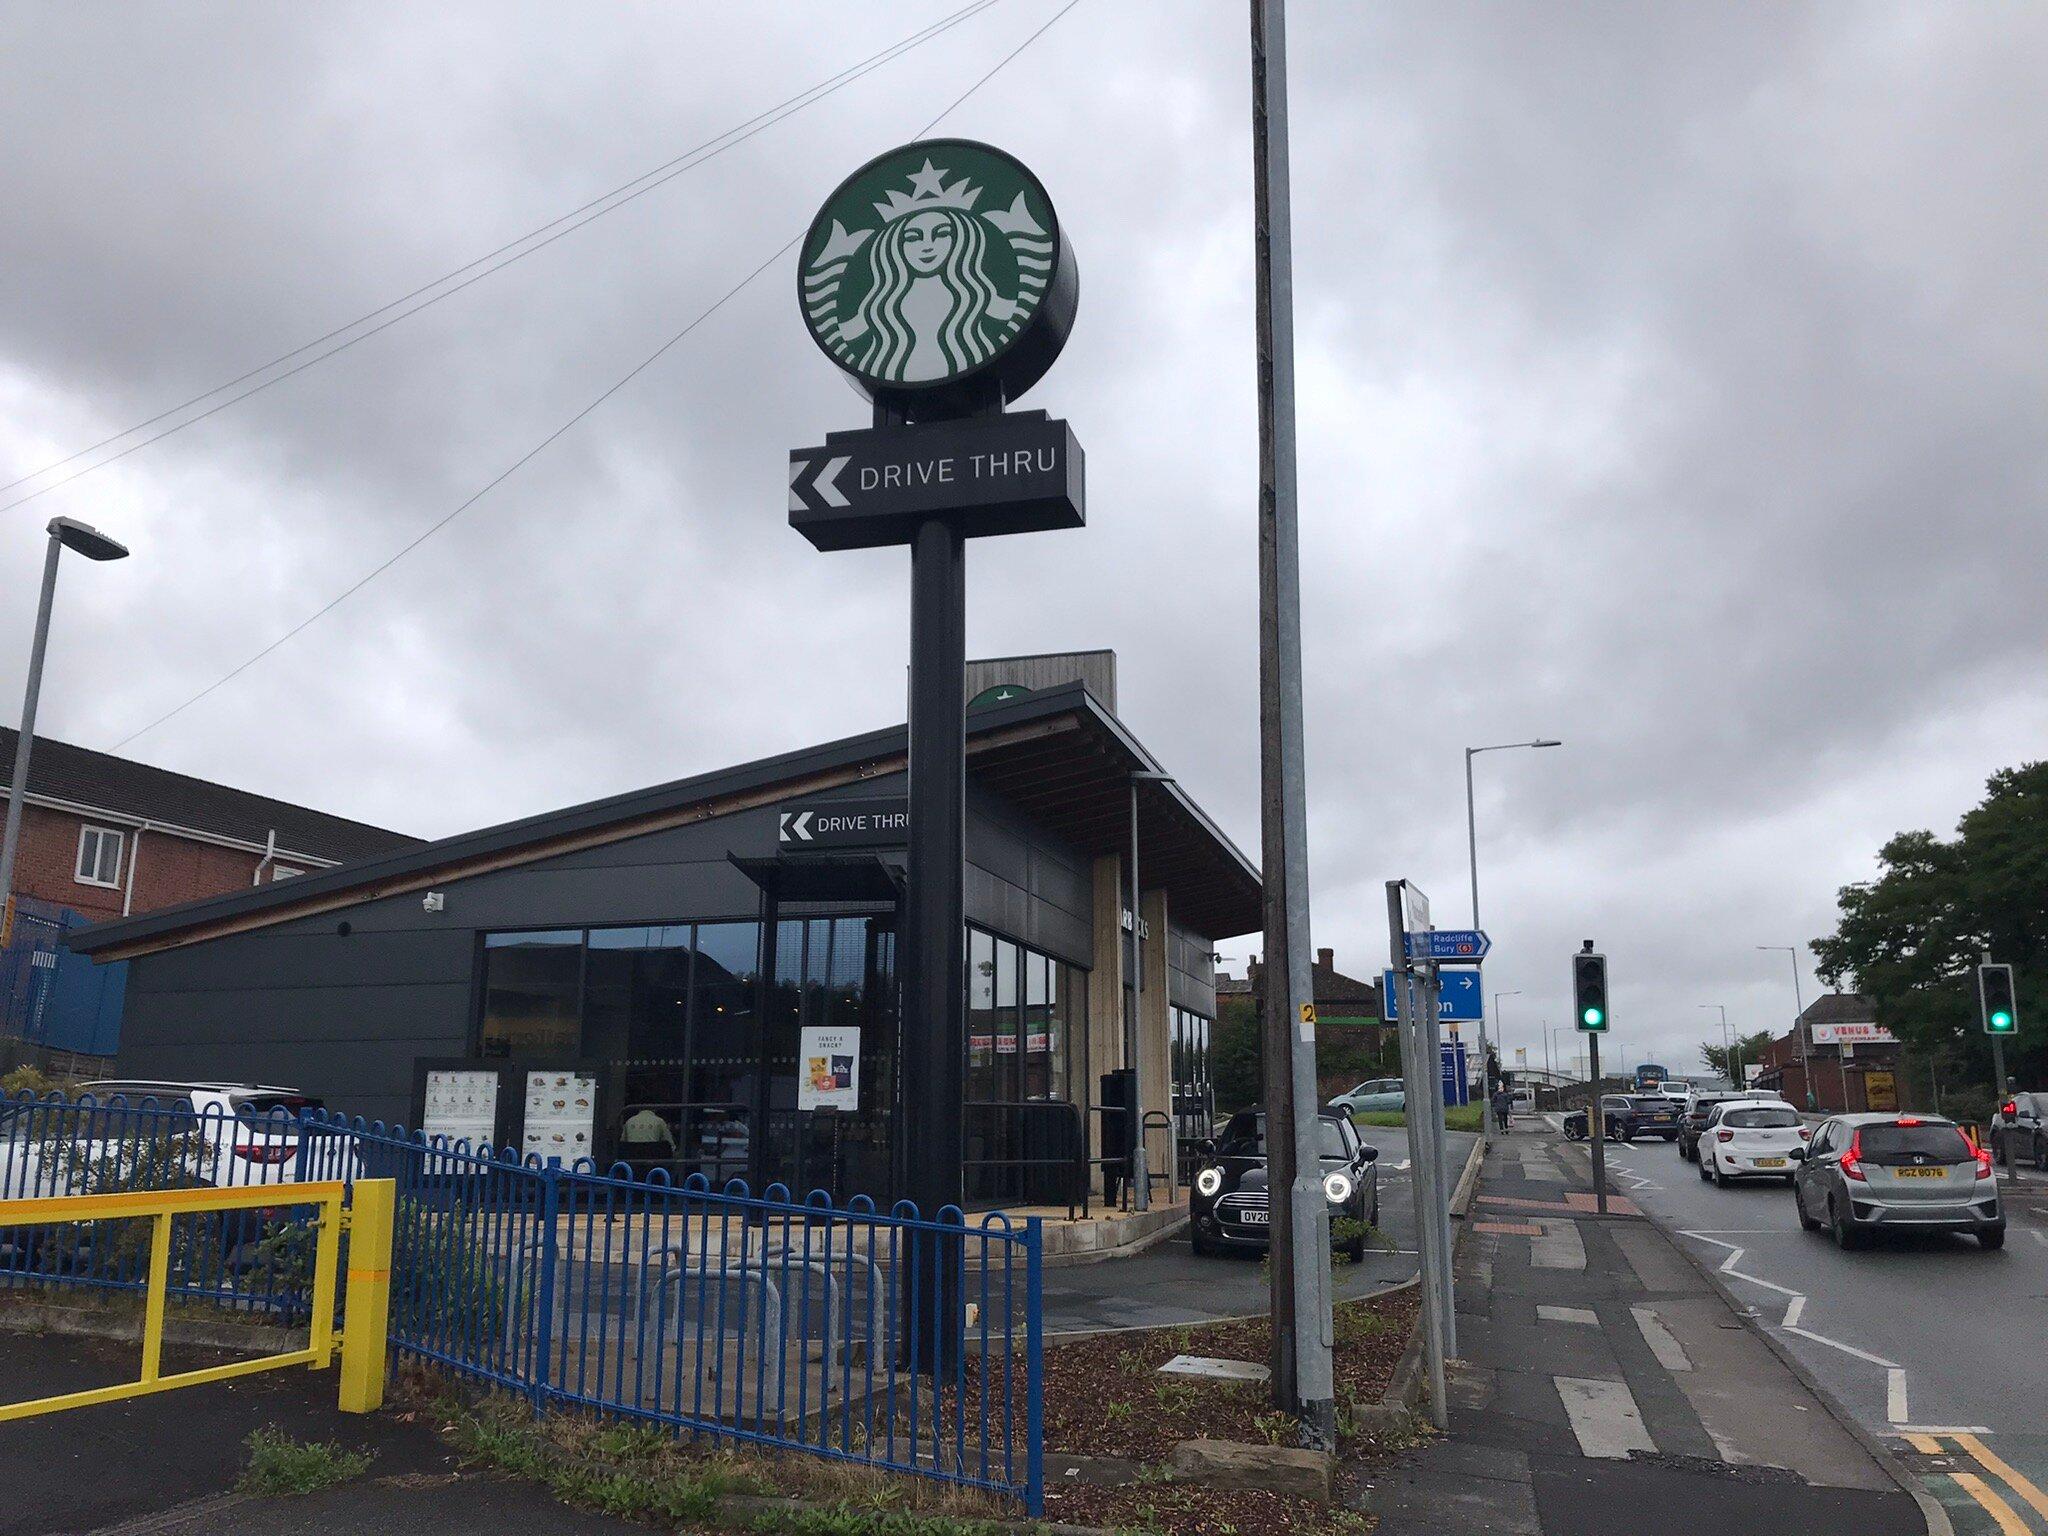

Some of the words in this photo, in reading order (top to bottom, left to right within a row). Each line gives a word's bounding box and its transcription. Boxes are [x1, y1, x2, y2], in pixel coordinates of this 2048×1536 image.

[861, 458, 954, 490] DRIVE
[969, 447, 1055, 478] THRU
[818, 815, 867, 832] DRIVE
[1433, 934, 1473, 942] Radcliffe
[1434, 945, 1455, 953] Bury
[1833, 1025, 1869, 1035] VENUS
